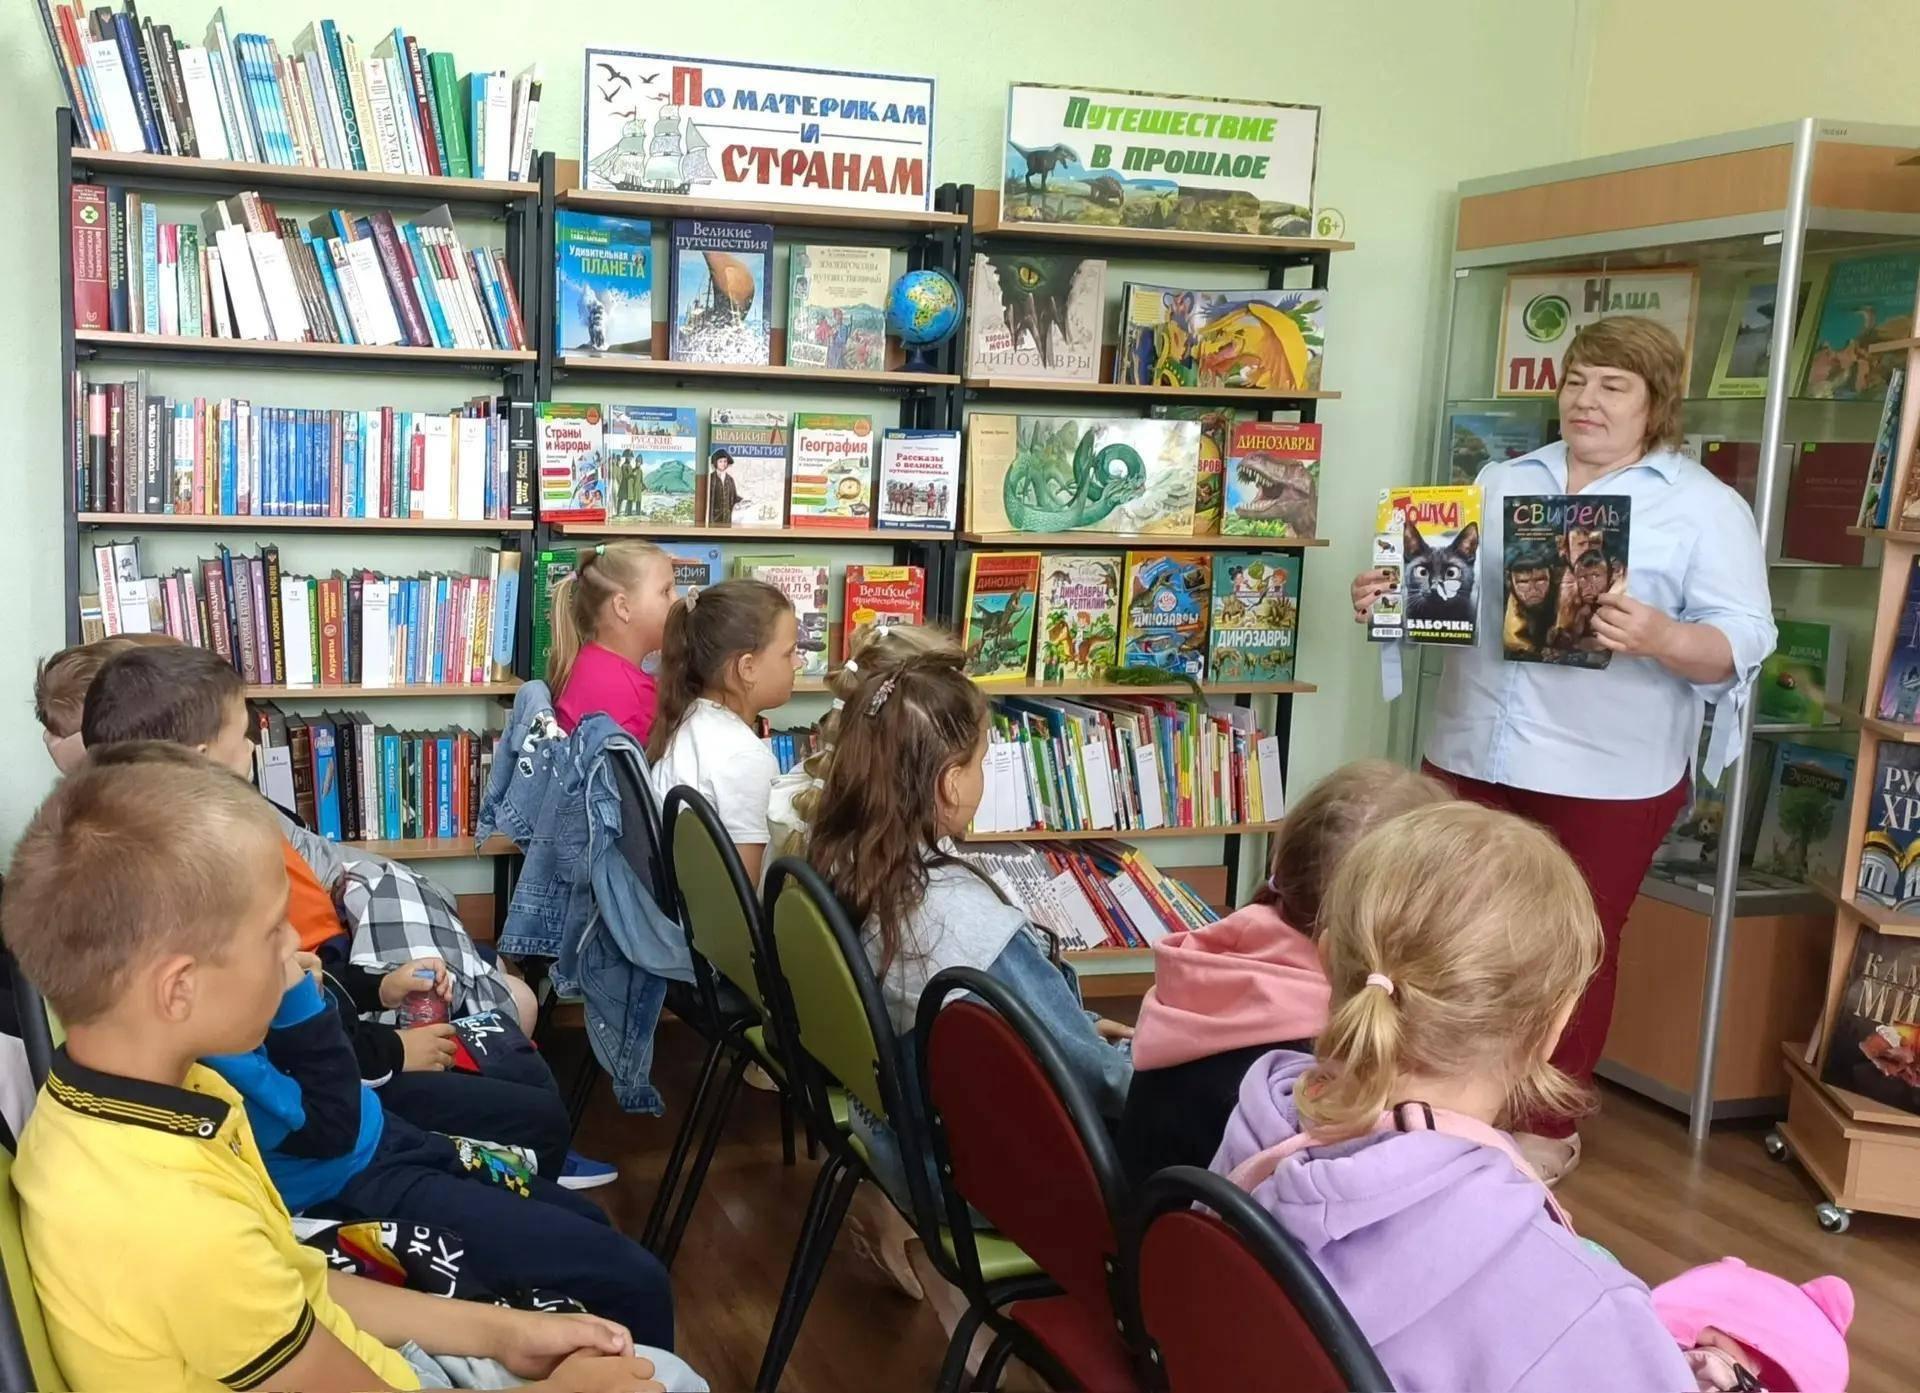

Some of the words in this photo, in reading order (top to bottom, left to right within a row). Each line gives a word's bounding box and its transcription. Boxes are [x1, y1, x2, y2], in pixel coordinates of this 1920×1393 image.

[733, 89, 927, 125] МАТЕРИКАМ
[1063, 96, 1278, 142] ПУТЕШЕСТВИЕ
[800, 123, 819, 144] И
[1090, 143, 1113, 168] В
[1122, 146, 1270, 179] ПРОШЛОЕ
[721, 144, 923, 196] СТРАНАМ
[693, 222, 752, 238] Великие
[1317, 215, 1342, 236] 6+
[676, 236, 768, 250] путешествия
[581, 257, 645, 278] ПЛАНЕТА
[545, 425, 582, 440] Страны
[546, 441, 552, 450] и
[554, 441, 591, 454] народы
[728, 445, 783, 456] ОТКРЫТИЯ
[801, 436, 868, 456] География
[1237, 435, 1315, 450] ДИНОЗАВРЫ
[896, 453, 944, 462] Рассказы
[860, 584, 912, 599] Великие
[1133, 613, 1199, 626] ДИНОЗАВРЫ
[1407, 619, 1473, 631] БАБОЧКИ:
[1218, 629, 1291, 647] ДИНОЗАВРЫ
[1884, 766, 1920, 793] РУ
